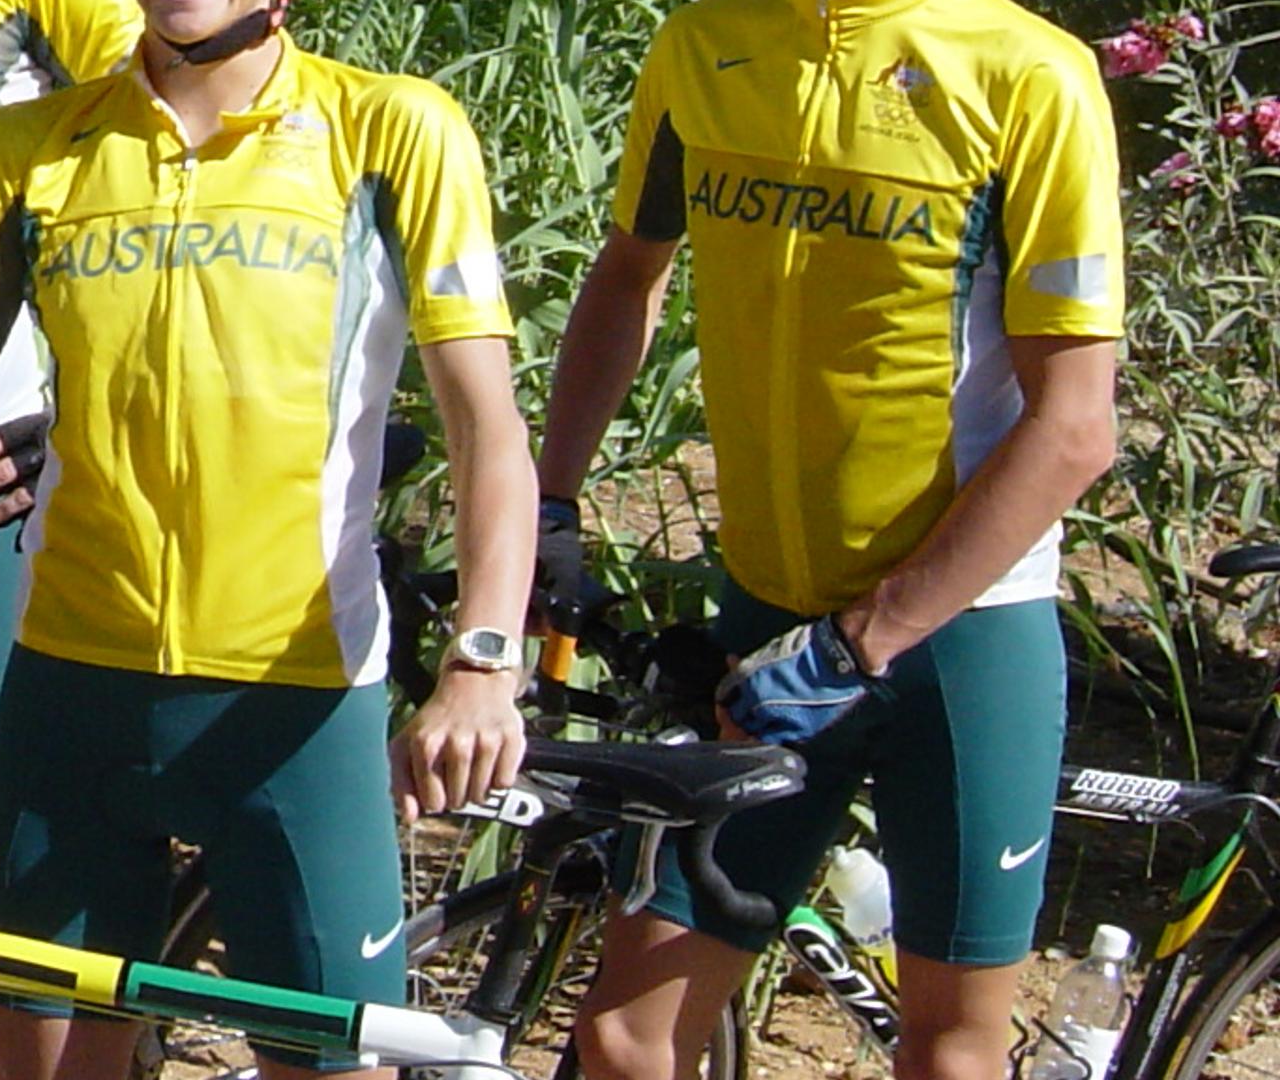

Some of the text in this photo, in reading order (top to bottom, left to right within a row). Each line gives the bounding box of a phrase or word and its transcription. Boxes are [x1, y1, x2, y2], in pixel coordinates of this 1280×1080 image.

[689, 170, 939, 248] AUSTRALIA
[40, 220, 339, 284] AUSTRALIA
[1073, 770, 1180, 802] ROBBO
